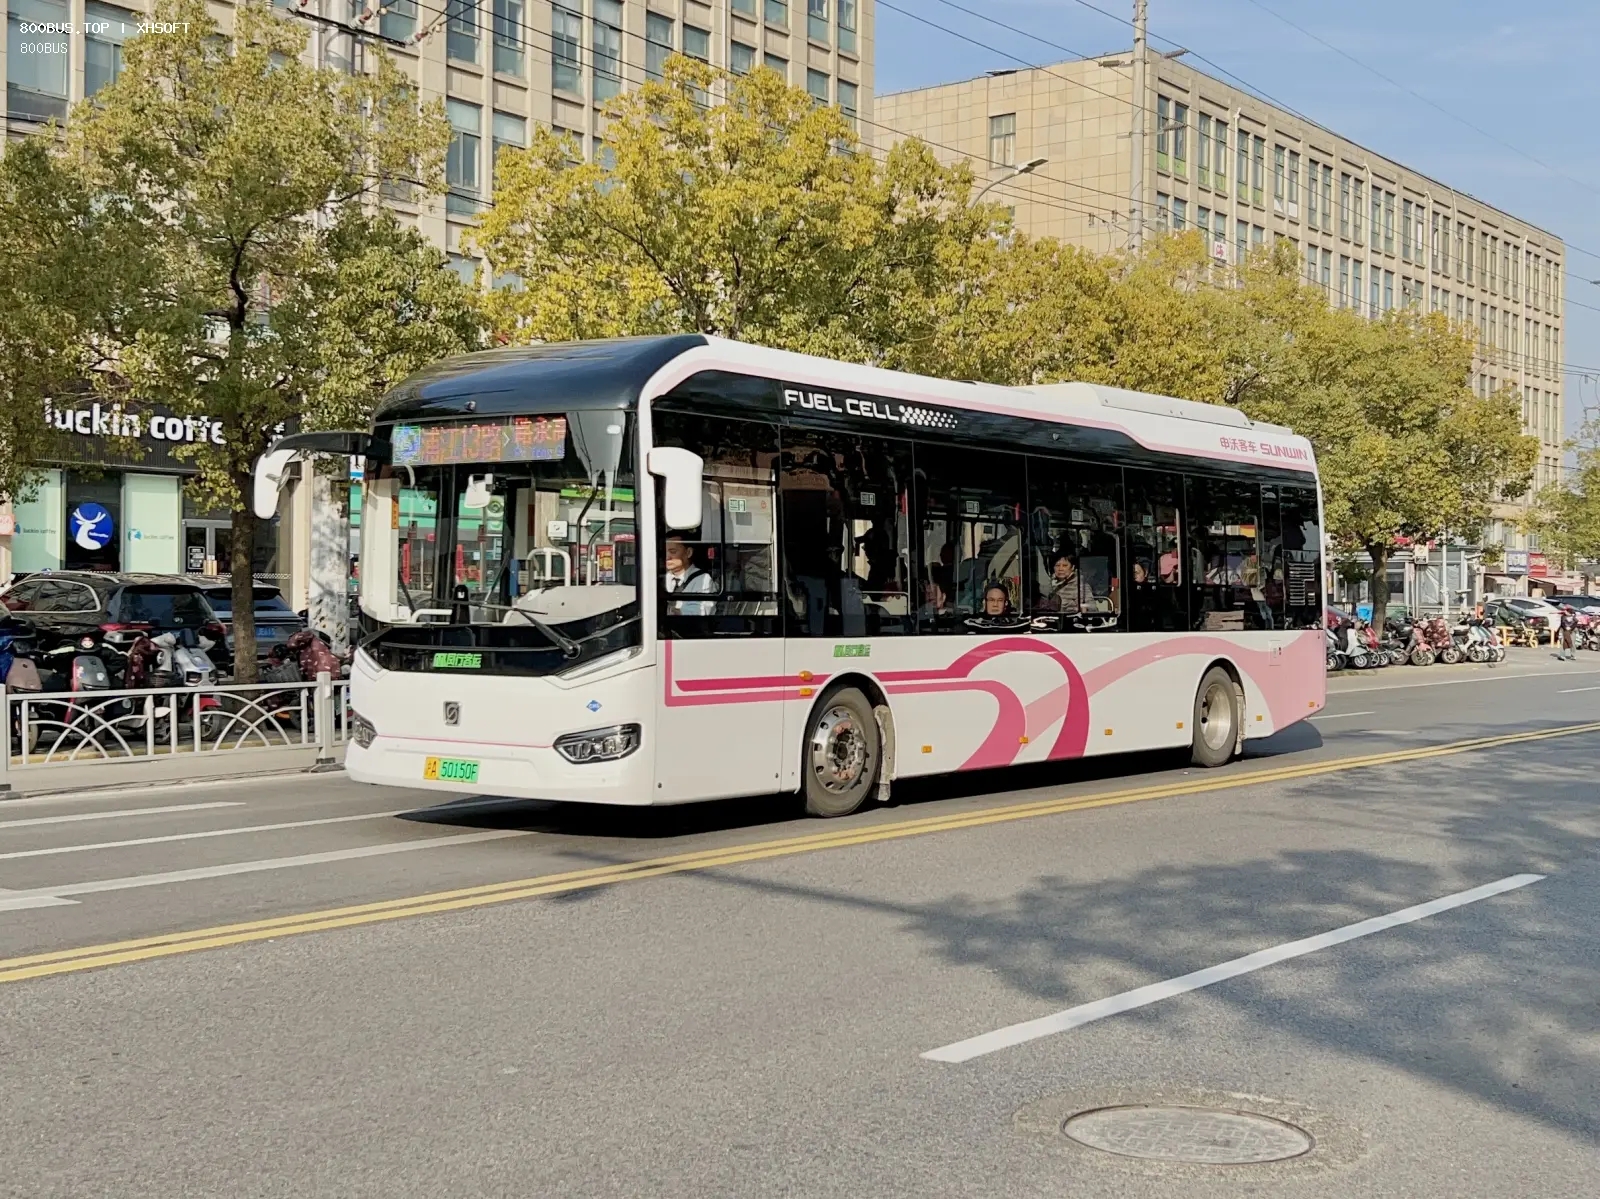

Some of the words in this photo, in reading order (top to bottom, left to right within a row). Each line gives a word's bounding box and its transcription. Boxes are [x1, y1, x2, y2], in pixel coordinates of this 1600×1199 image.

[784, 389, 843, 413] FUEL
[845, 398, 900, 421] CELL
[1219, 436, 1258, 454] 申沃客车
[1260, 443, 1308, 461] SUNWIN
